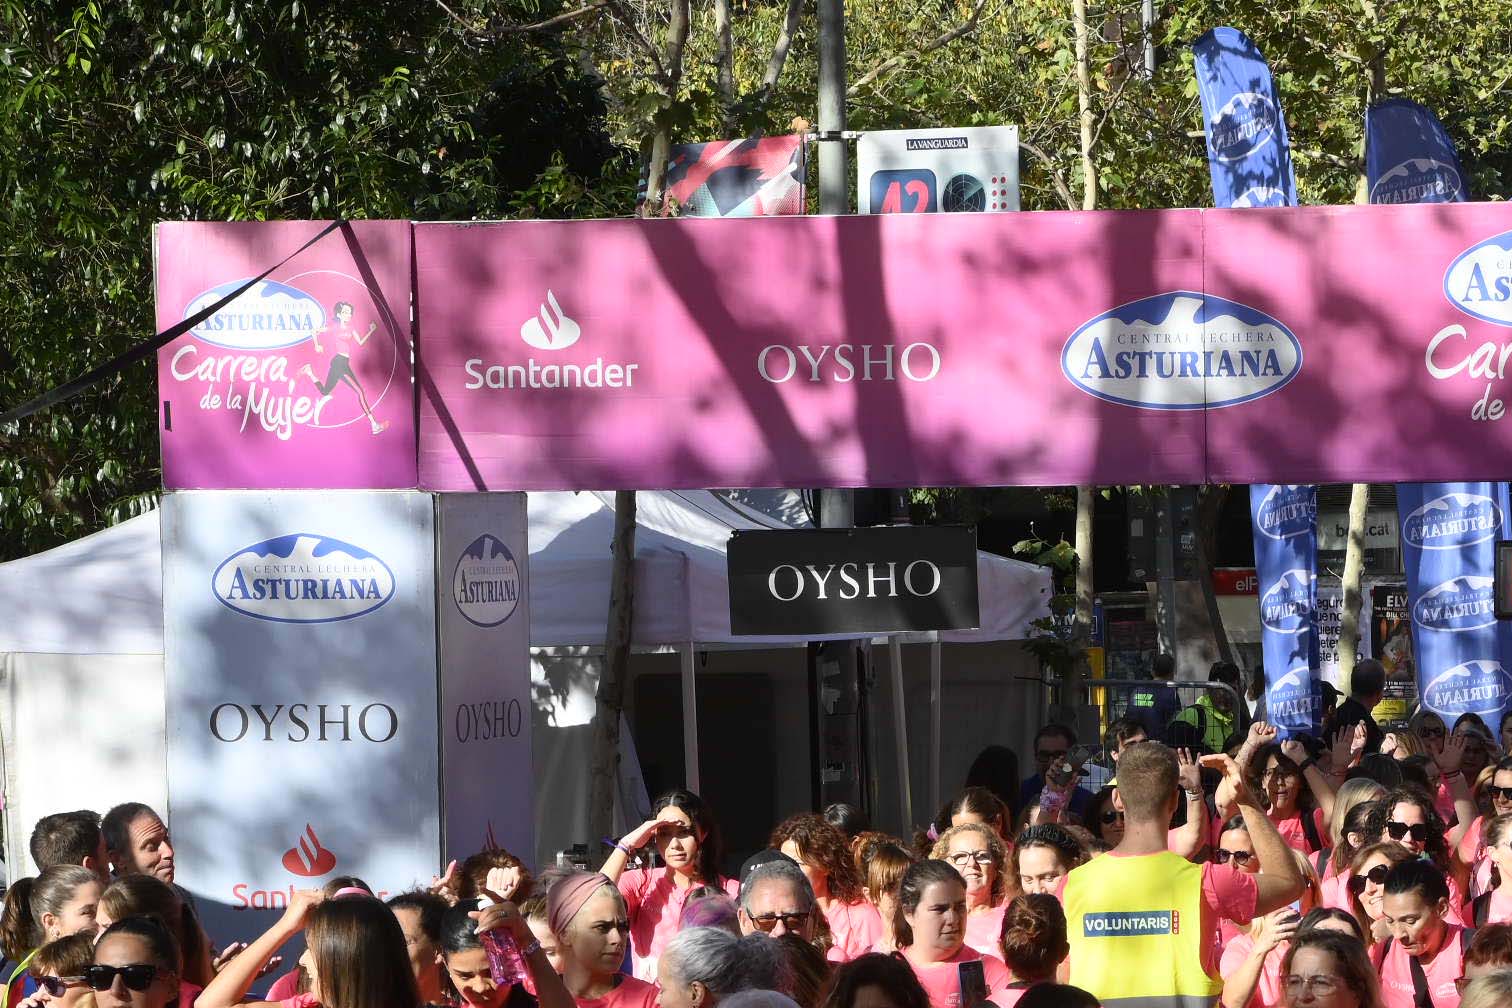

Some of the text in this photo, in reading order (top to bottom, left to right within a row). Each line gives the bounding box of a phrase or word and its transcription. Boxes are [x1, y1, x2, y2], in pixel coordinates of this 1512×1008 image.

[171, 344, 290, 384] Carrera
[465, 357, 638, 390] Santander
[757, 342, 941, 384] OYSHO
[1081, 337, 1283, 379] ASTURIANA
[200, 379, 333, 441] de la Mujer
[1471, 383, 1505, 422] de
[226, 567, 383, 601] ASTURIANA
[254, 563, 375, 573] CENTRAL LECHERA
[458, 568, 517, 604] ASTURIANA
[767, 559, 941, 602] OYSHO
[209, 702, 398, 743] OYSHO
[456, 699, 522, 744] OYSHO
[1085, 916, 1169, 933] VOLUNTARIS
